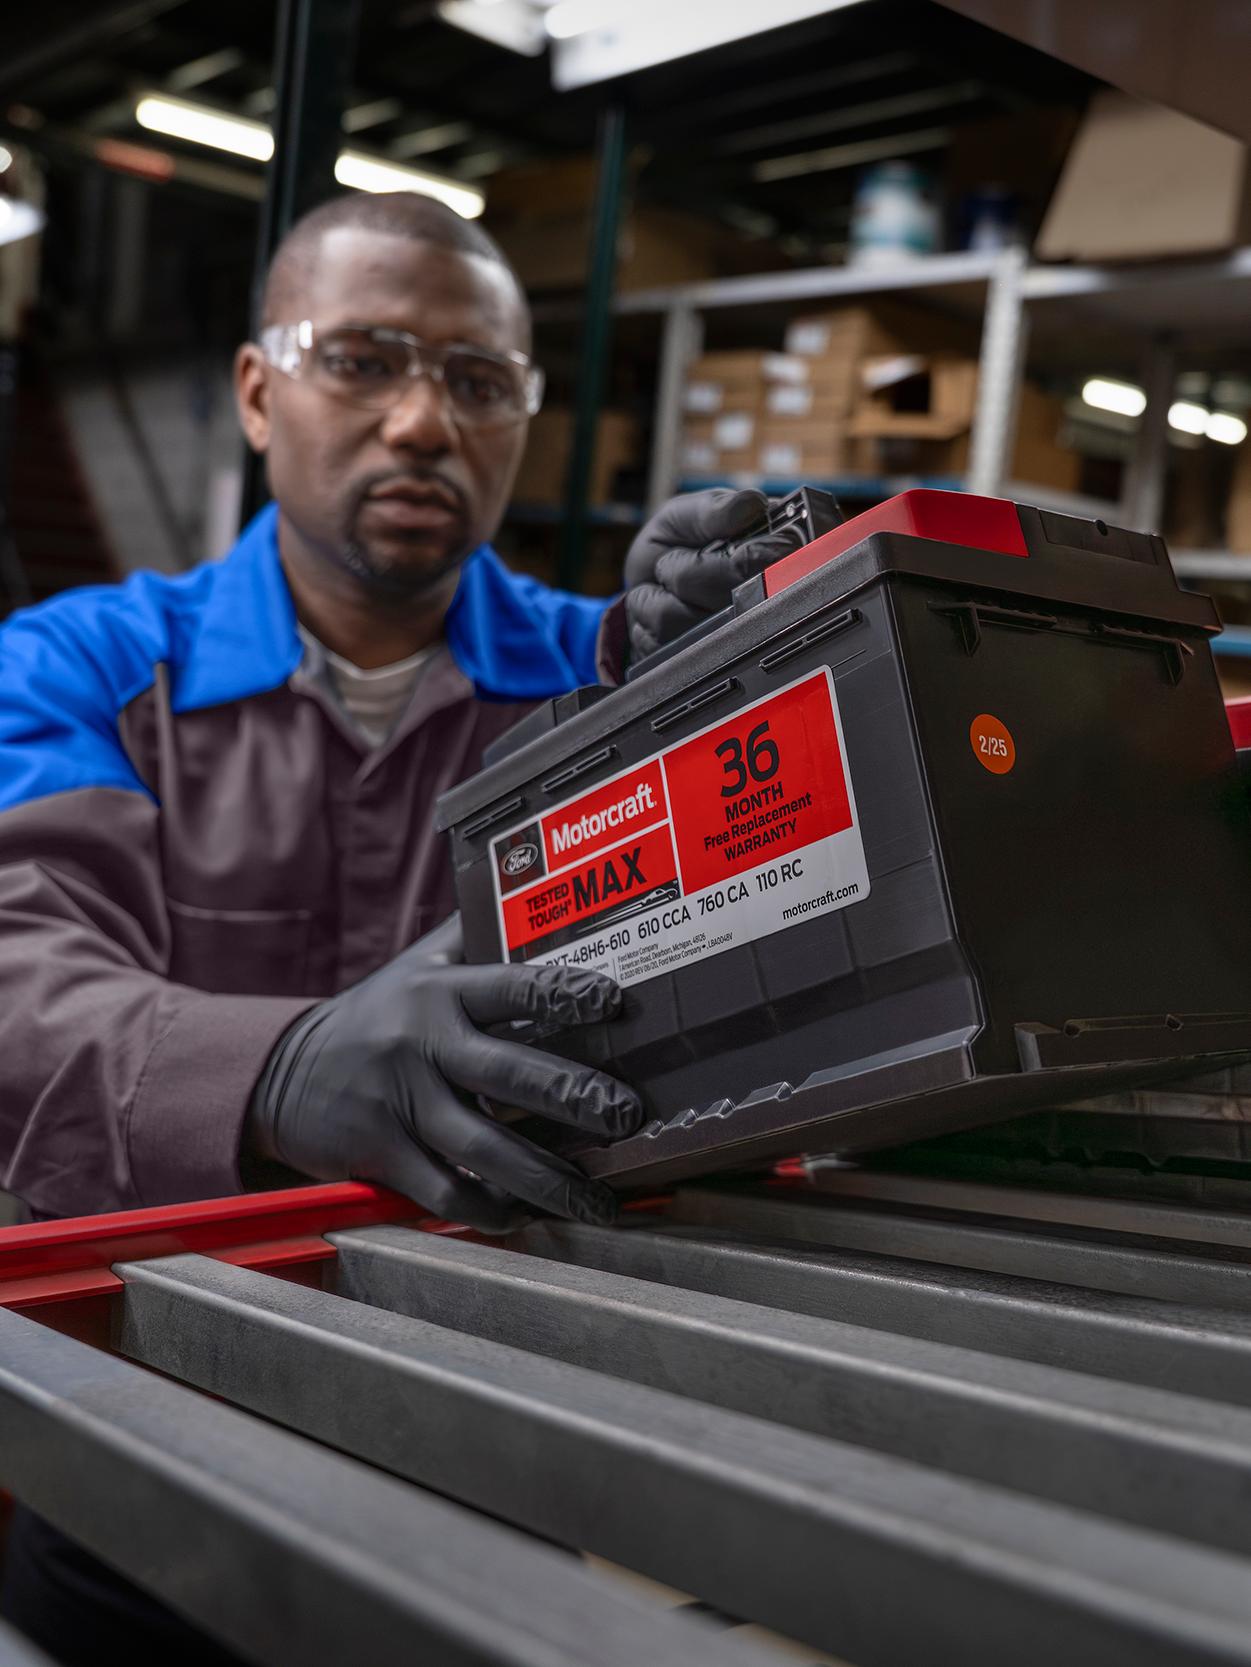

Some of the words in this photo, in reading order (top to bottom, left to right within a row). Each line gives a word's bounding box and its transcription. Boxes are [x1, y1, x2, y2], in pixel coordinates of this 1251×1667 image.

[714, 720, 780, 798] 36
[979, 735, 1008, 757] 2/25
[551, 783, 655, 855] Motorcraft
[704, 831, 730, 851] Free
[731, 792, 812, 841] Replacement
[725, 782, 784, 823] MONTH
[508, 850, 532, 872] Ford
[724, 818, 797, 862] WARRANTY
[525, 883, 569, 913] TESTED
[572, 846, 647, 912] MAX
[638, 918, 660, 940] 610
[662, 905, 692, 929] CCA
[697, 892, 725, 916] 760
[727, 881, 750, 903] CA
[756, 869, 778, 892] 110
[780, 858, 804, 883] RC
[782, 883, 859, 920] motorcraft.com
